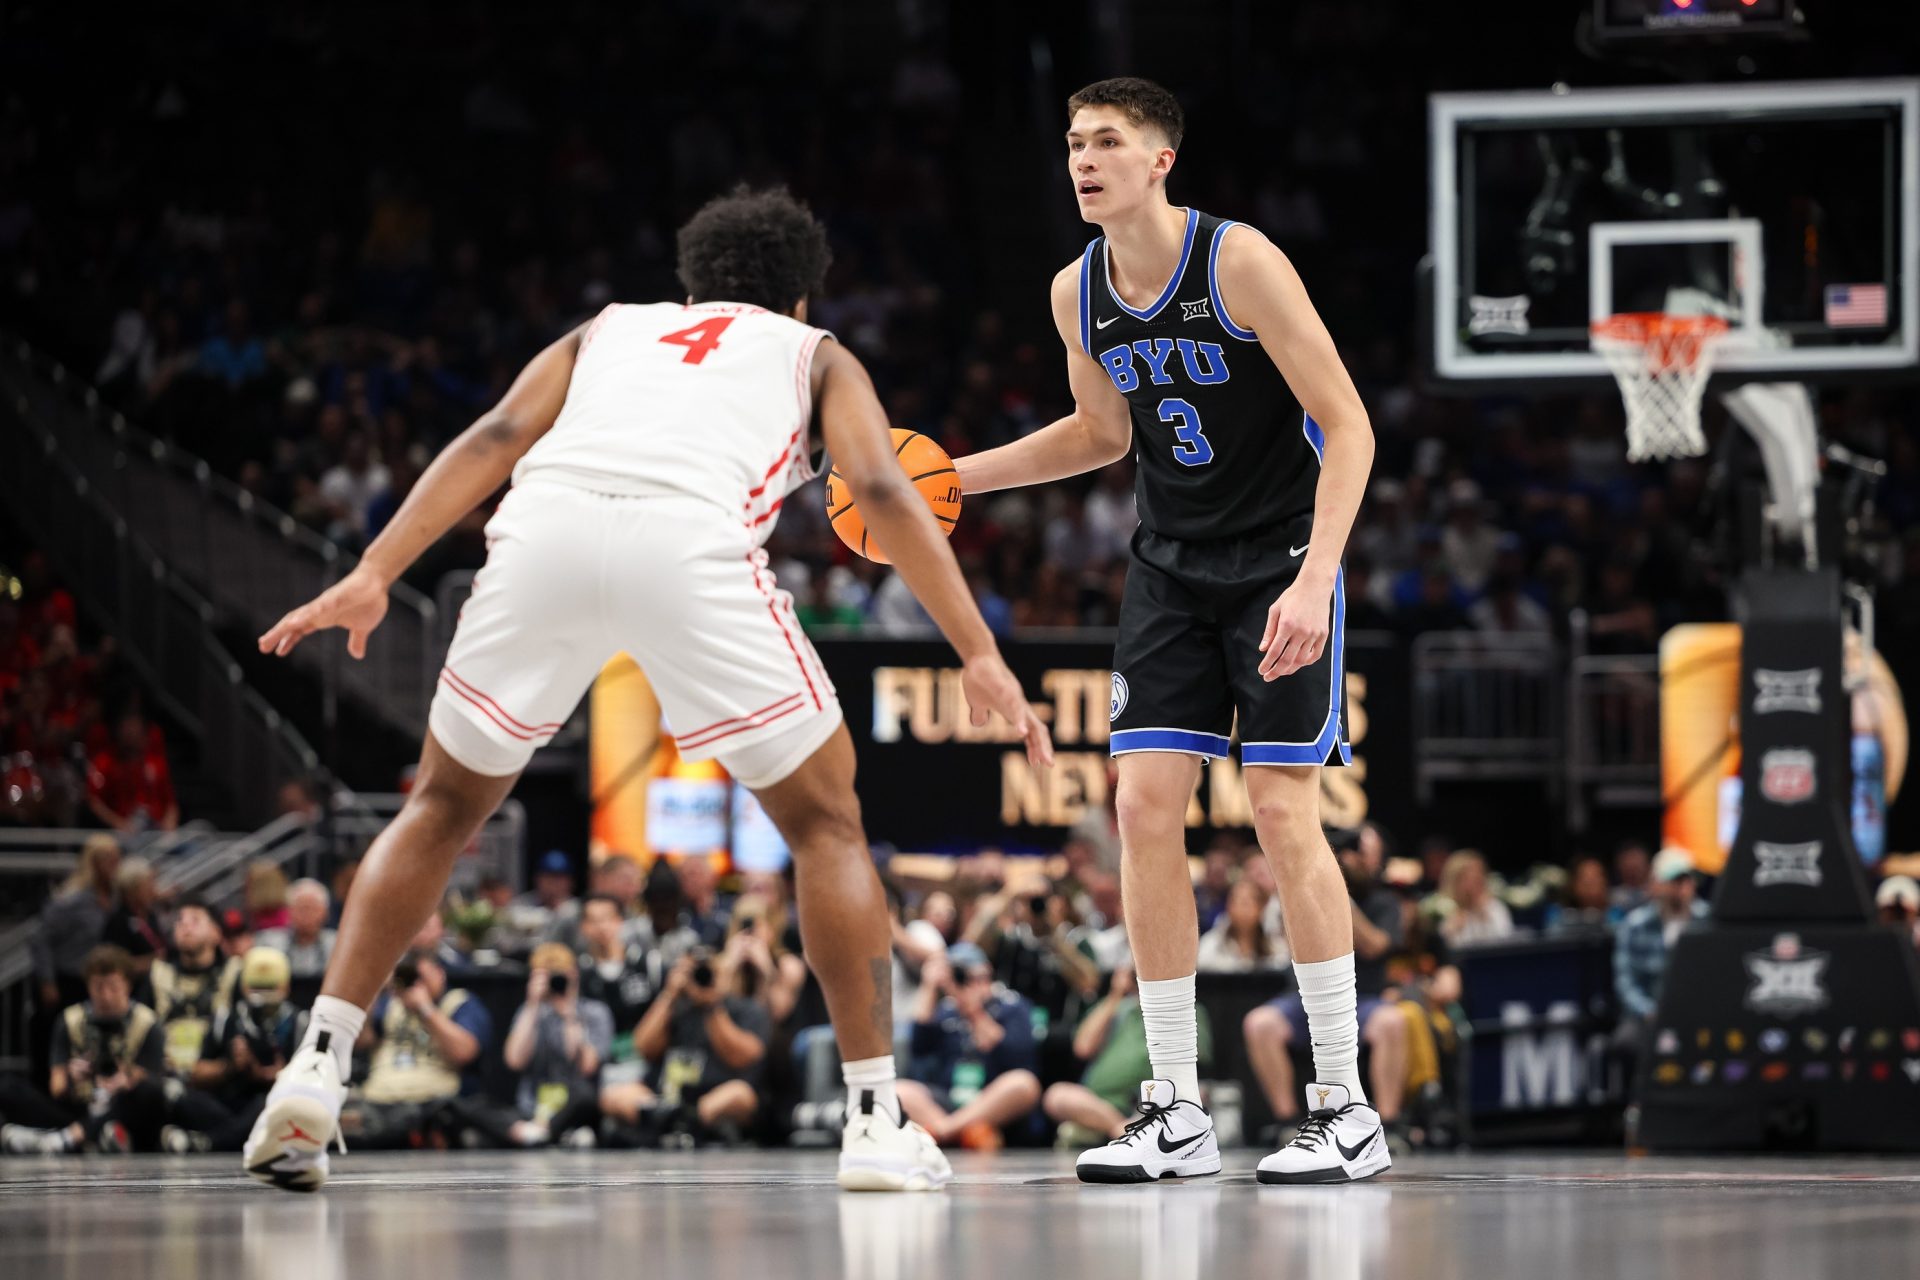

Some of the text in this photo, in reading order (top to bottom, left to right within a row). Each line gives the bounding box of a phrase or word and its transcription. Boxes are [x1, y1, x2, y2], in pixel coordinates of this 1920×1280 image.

[658, 316, 735, 365] 4
[1100, 338, 1230, 393] BYU
[1157, 398, 1214, 467] 3
